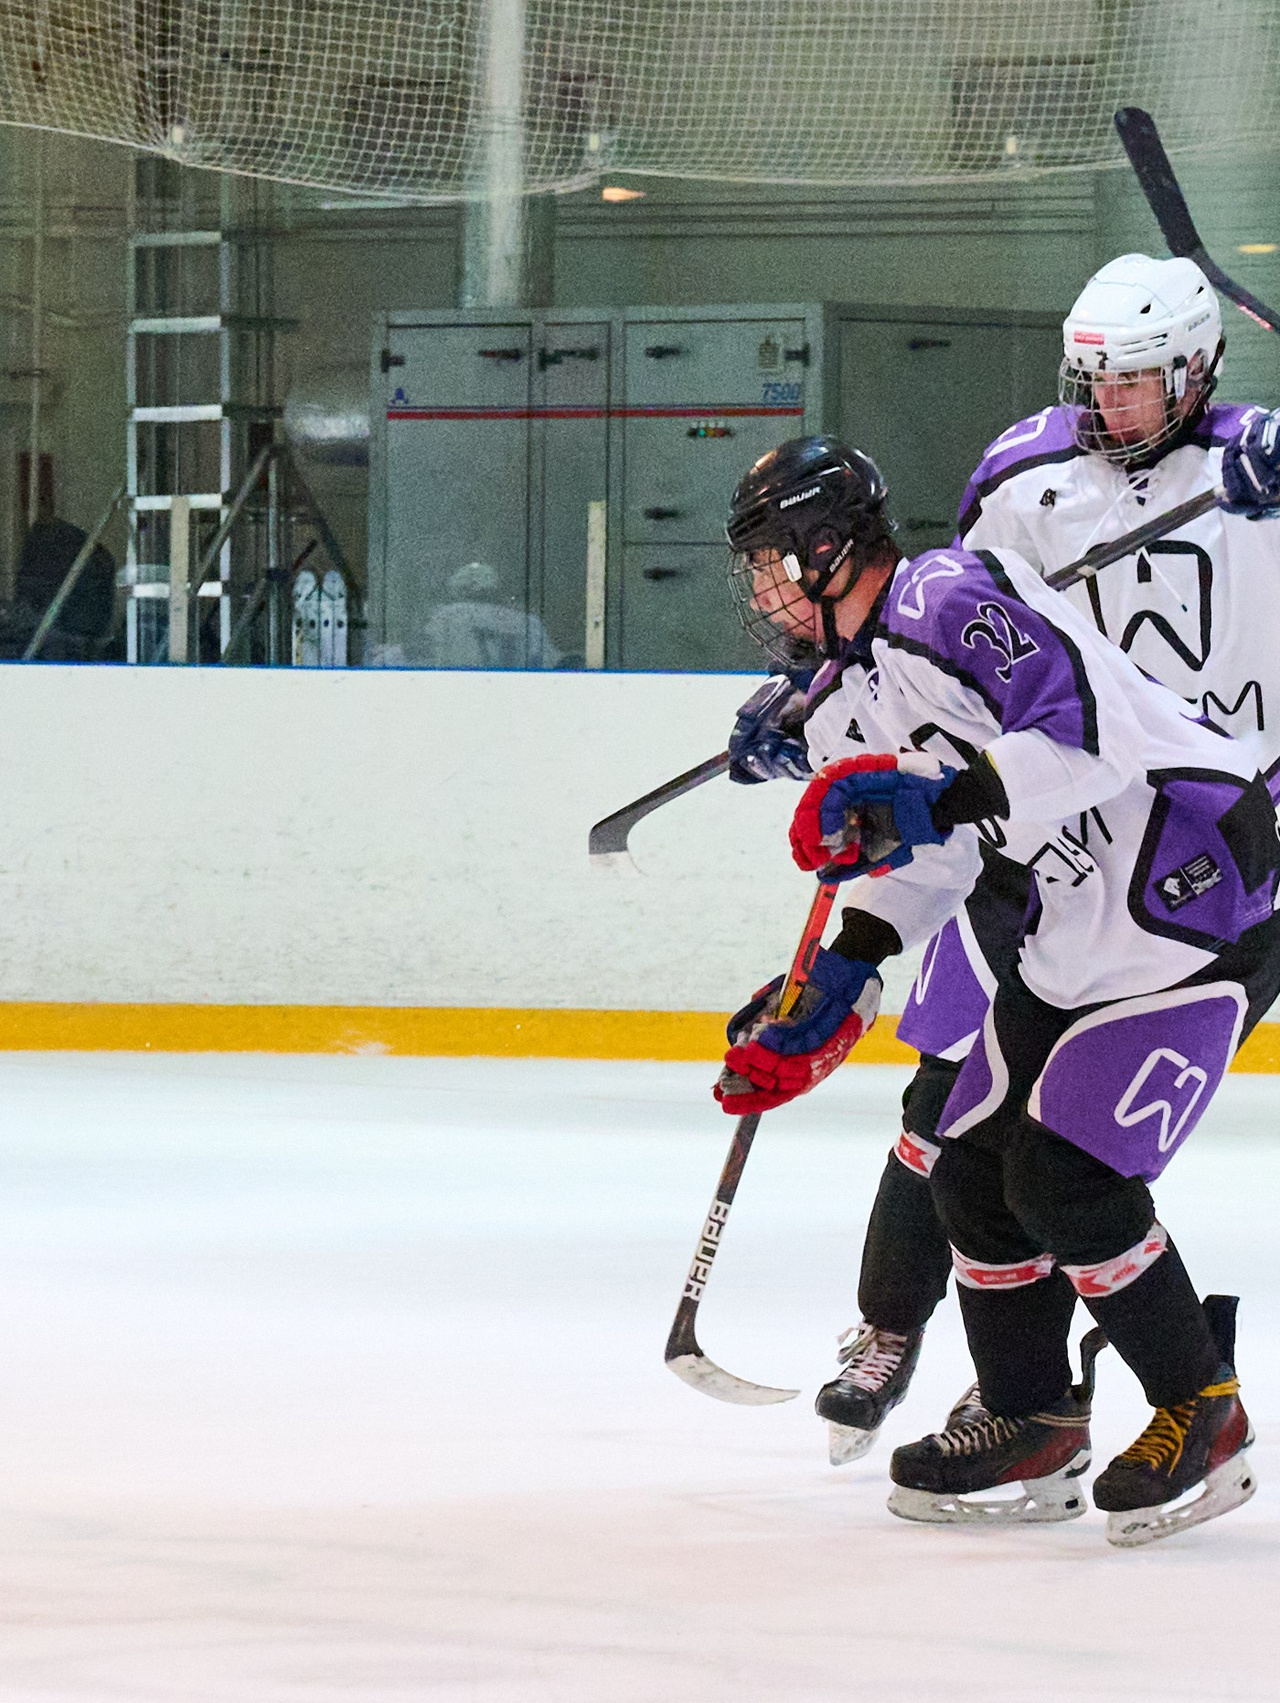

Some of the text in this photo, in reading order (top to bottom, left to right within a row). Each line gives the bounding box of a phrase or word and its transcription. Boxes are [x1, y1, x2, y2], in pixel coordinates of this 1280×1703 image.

[829, 539, 854, 573] BAUER
[961, 600, 1039, 683] 32
[682, 1200, 732, 1303] BAUER
